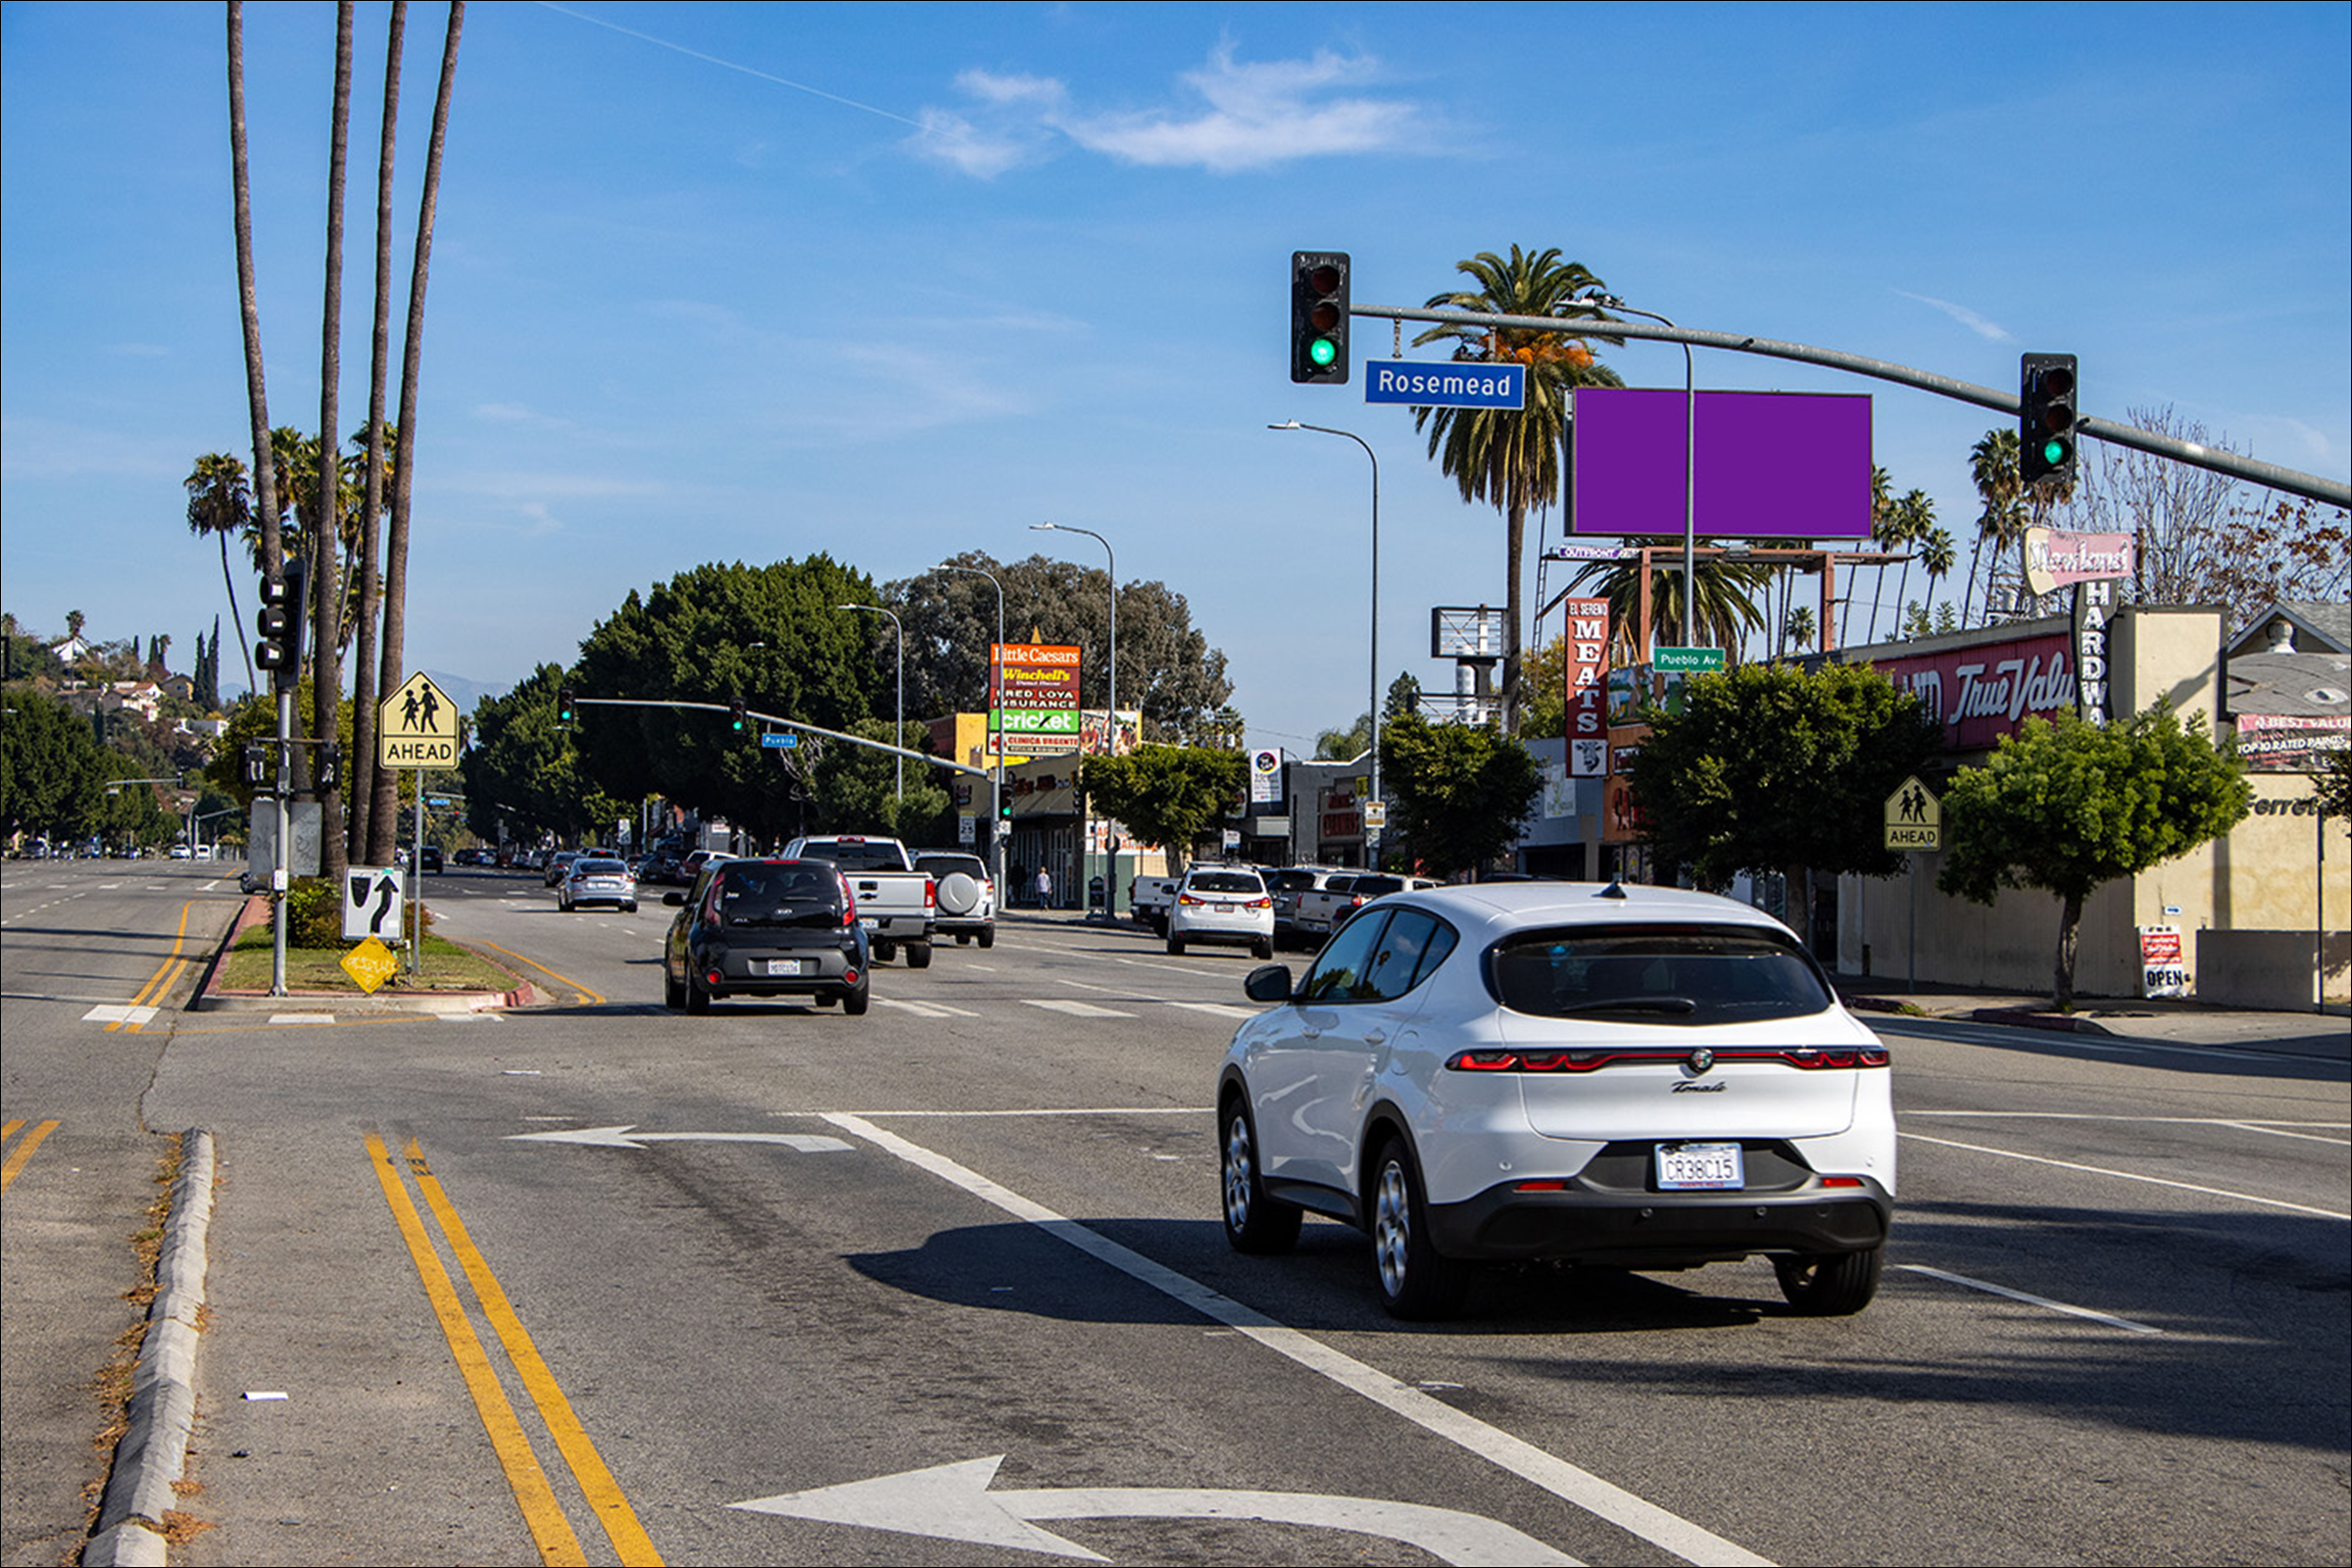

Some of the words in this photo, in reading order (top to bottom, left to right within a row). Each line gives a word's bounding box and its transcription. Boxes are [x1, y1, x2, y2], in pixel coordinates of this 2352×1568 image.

[1379, 369, 1511, 397] Rosemead
[994, 647, 1028, 662] Little
[1029, 648, 1079, 663] Caesars
[1661, 654, 1698, 665] Pueblo
[1702, 655, 1717, 664] Av
[2082, 582, 2111, 730] HARDWA
[1004, 667, 1070, 681] Winchell's
[1573, 619, 1602, 732] MEATS
[1948, 663, 2009, 724] True
[1996, 651, 2077, 721] Valu
[993, 699, 1077, 709] INSURANCE
[1004, 711, 1071, 729] cricket
[1007, 736, 1041, 745] CLINICA
[2273, 739, 2306, 751] RATED
[387, 744, 452, 760] AHEAD
[2248, 796, 2328, 816] erret
[1889, 830, 1936, 843] AHEAD
[2147, 969, 2183, 986] OPEN
[1671, 1081, 1727, 1093] Tonale
[1666, 1159, 1733, 1180] CR38C15
